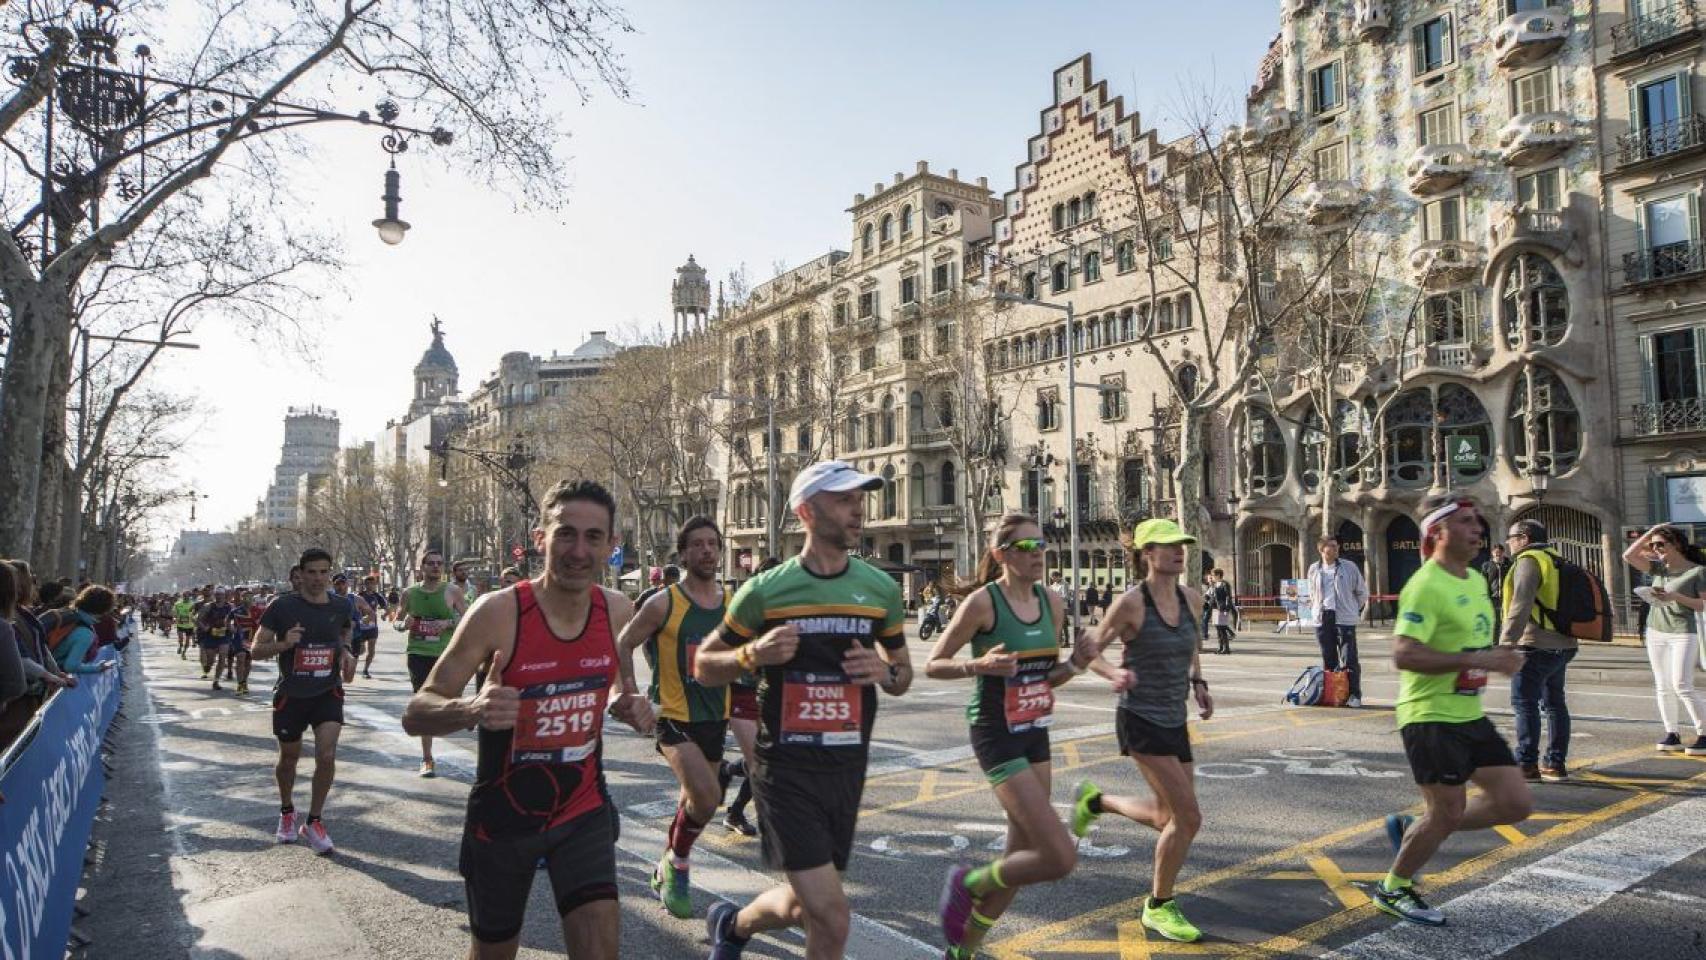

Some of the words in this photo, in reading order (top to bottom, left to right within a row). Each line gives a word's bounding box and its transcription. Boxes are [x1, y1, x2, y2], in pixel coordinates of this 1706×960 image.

[806, 686, 844, 699] TONI
[536, 693, 596, 713] XAVIER
[799, 702, 850, 720] 2353
[536, 710, 594, 737] 2519
